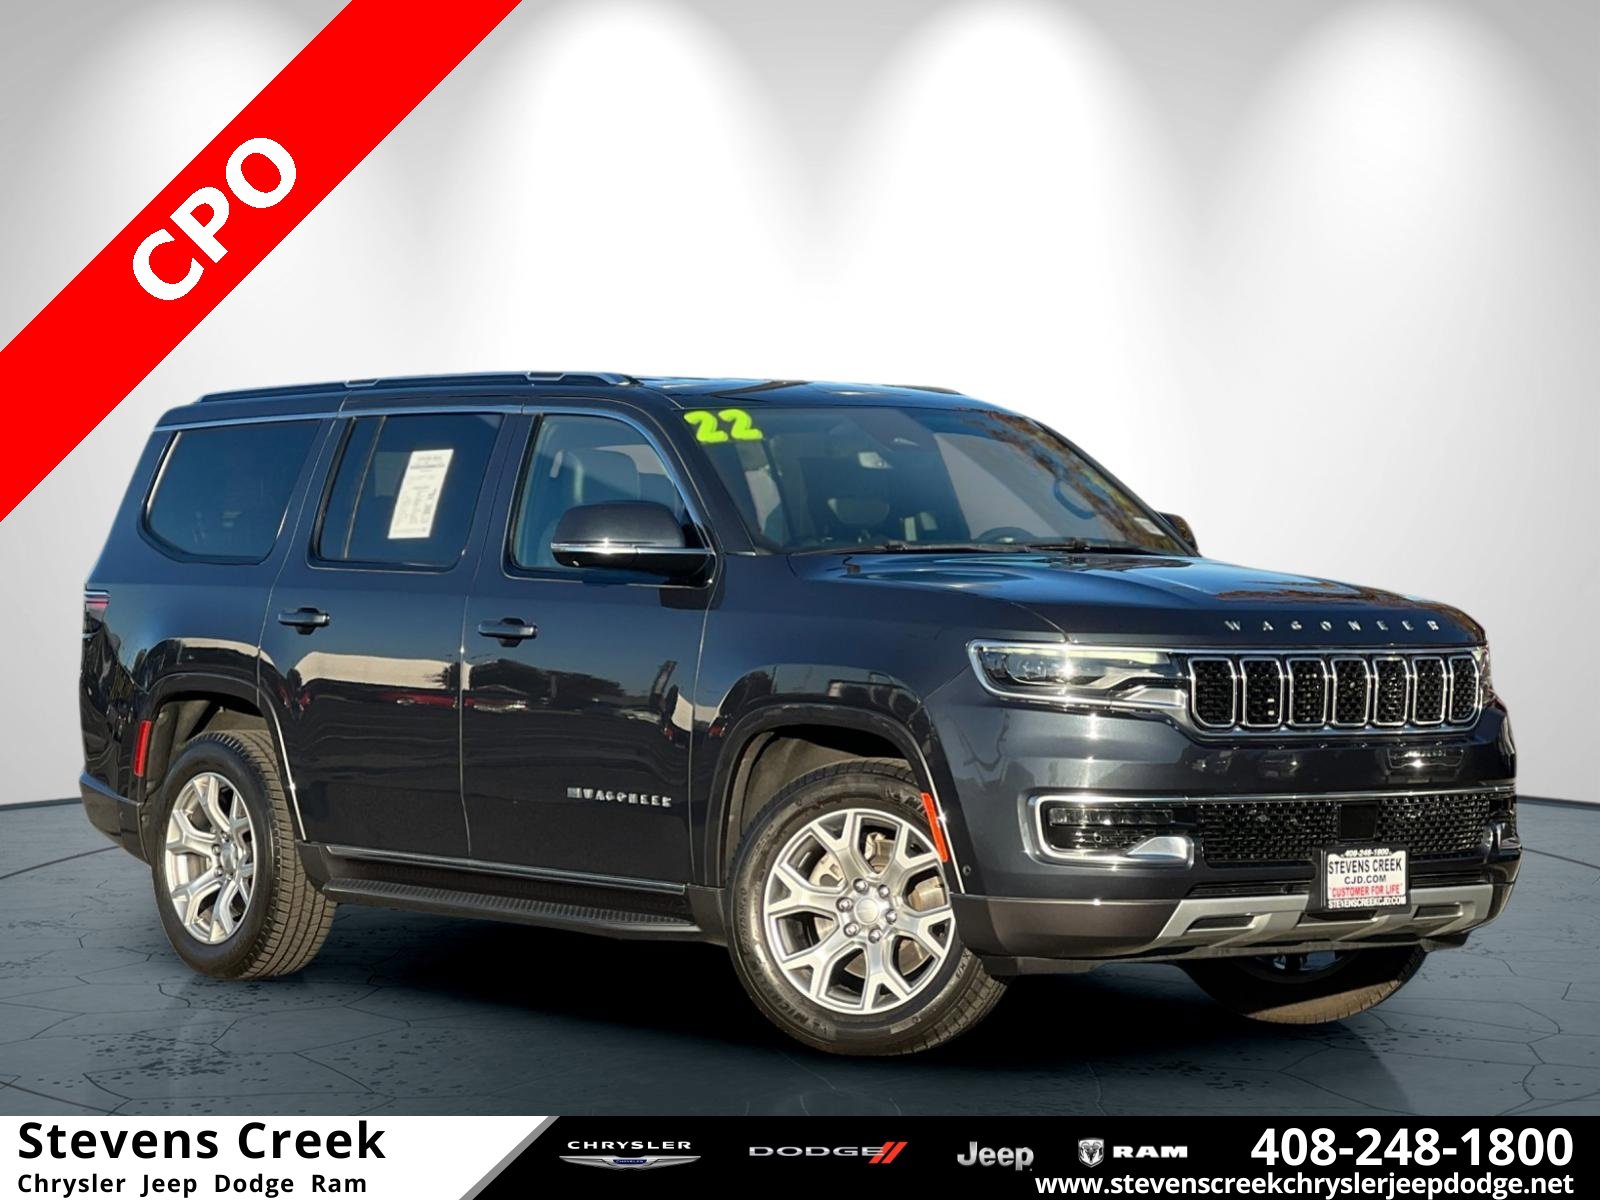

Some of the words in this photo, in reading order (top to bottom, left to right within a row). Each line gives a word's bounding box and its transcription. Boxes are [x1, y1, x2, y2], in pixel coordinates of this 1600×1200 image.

[683, 408, 763, 443] 22
[1224, 619, 1439, 632] WAGONEER
[1328, 860, 1370, 875] STEVENS
[1372, 858, 1402, 873] CREEK
[1344, 874, 1387, 885] CJD.COM
[1332, 886, 1369, 898] CUSTOMER
[1371, 886, 1384, 894] FOR
[1385, 884, 1401, 894] LIFE
